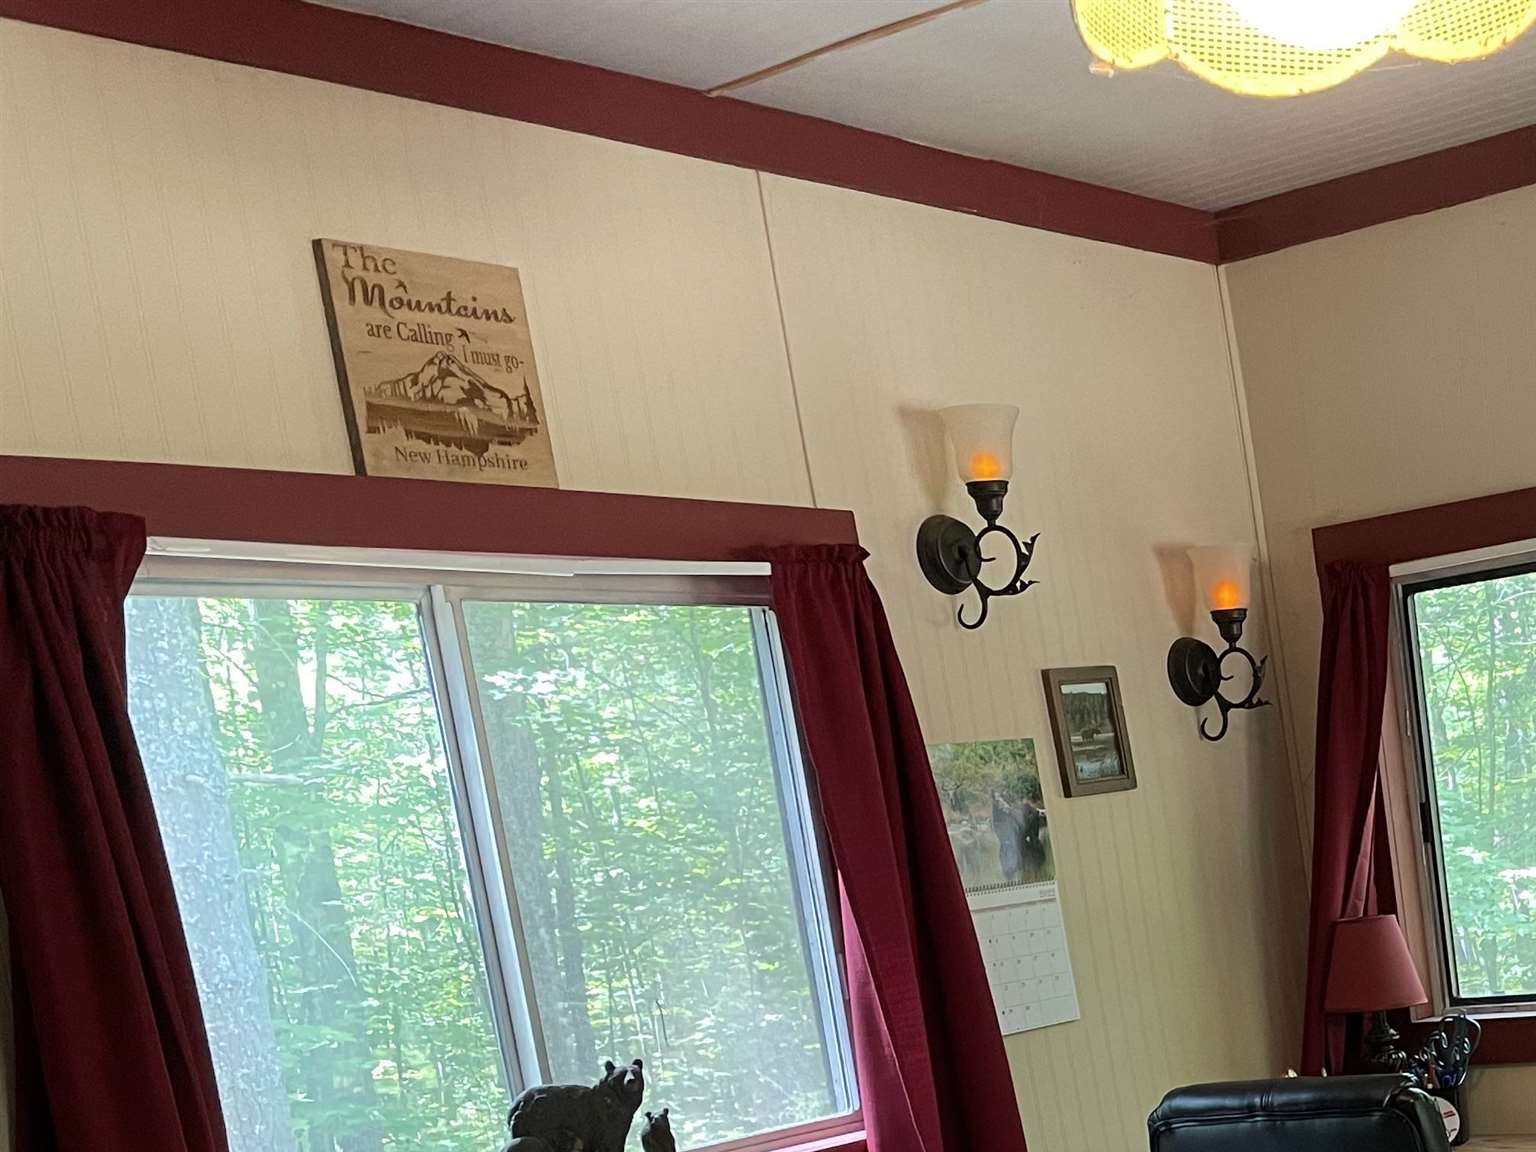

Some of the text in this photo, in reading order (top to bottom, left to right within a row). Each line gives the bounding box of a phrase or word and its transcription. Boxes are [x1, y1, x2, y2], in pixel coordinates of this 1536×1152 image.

[332, 243, 397, 276] The
[341, 269, 516, 323] Mountains
[365, 321, 455, 352] are Calling
[470, 350, 501, 367] must
[394, 446, 528, 472] New Hampshire
